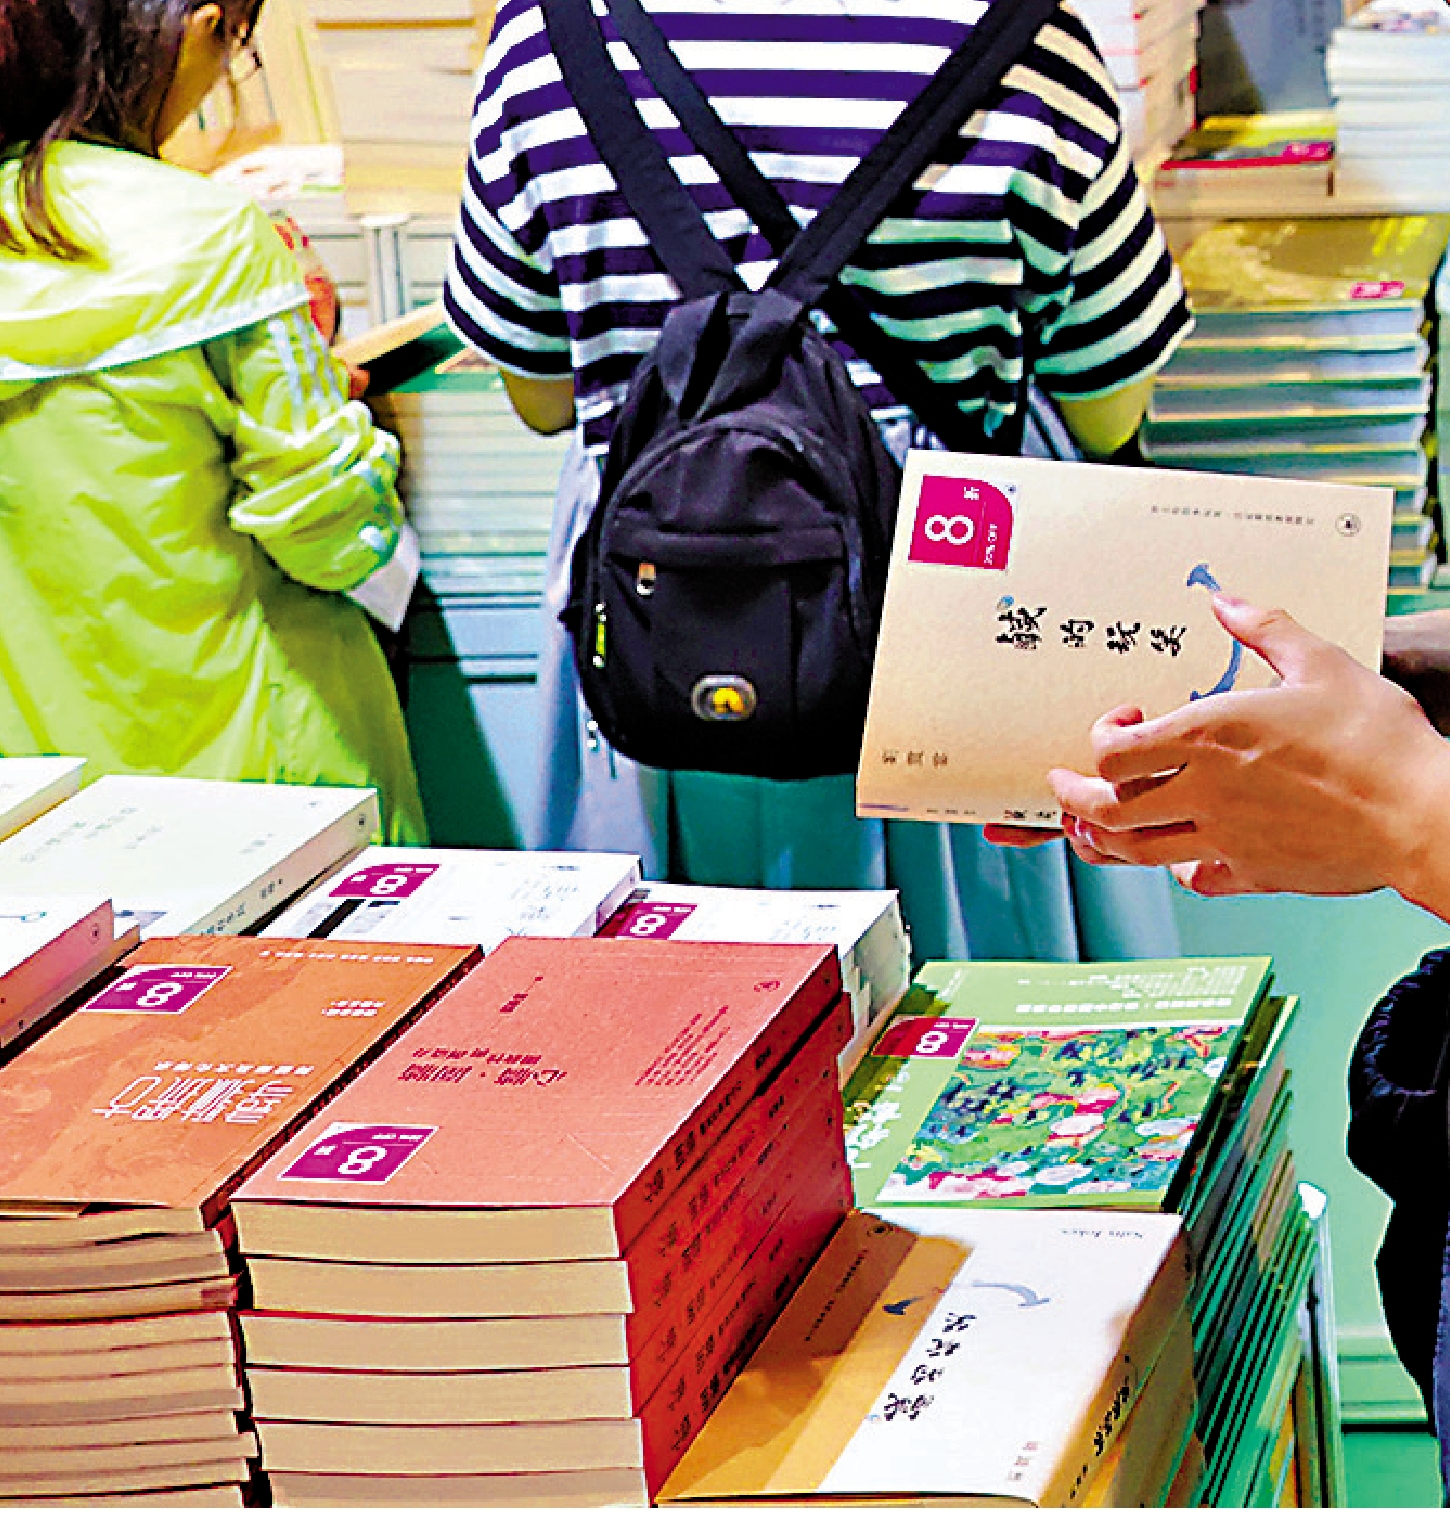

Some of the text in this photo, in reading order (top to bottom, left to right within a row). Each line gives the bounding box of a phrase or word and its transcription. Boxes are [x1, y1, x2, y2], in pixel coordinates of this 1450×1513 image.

[925, 514, 975, 545] 8
[369, 874, 407, 895] 8
[628, 913, 667, 936] 8
[136, 982, 184, 1007] 8
[916, 1031, 949, 1053] 8
[337, 1145, 388, 1175] 8
